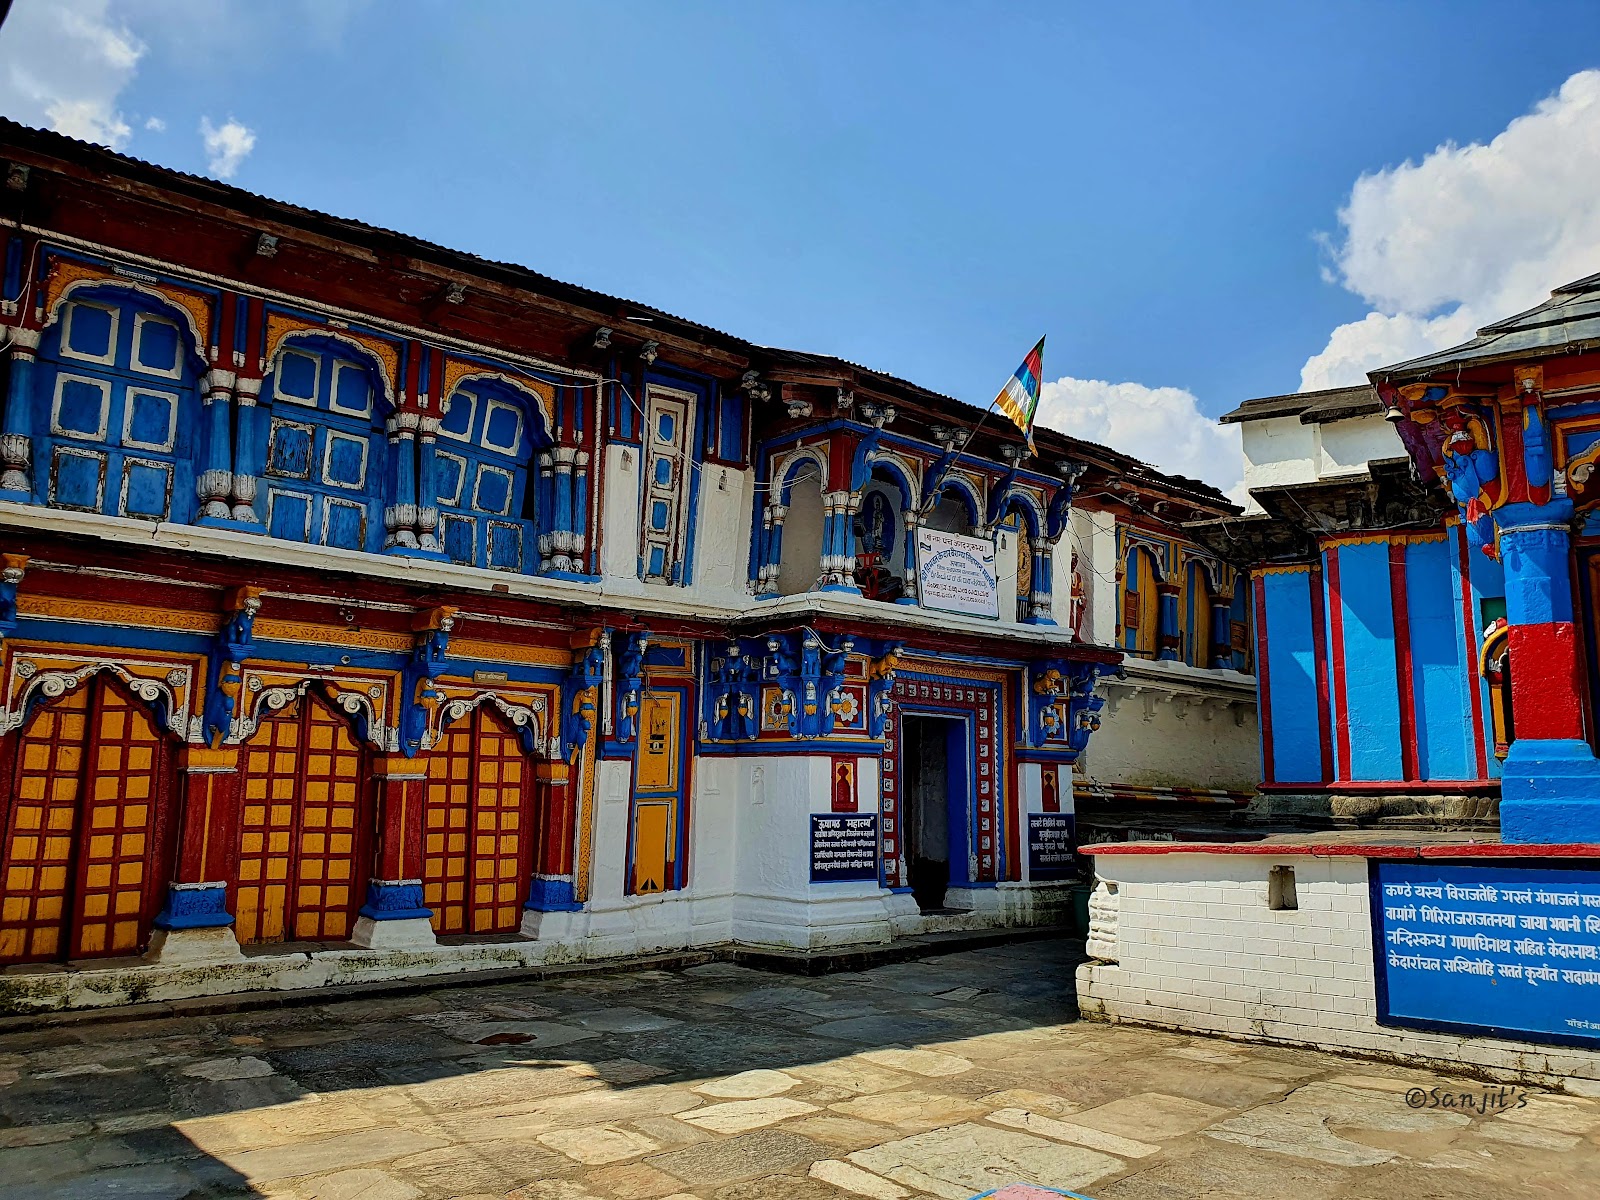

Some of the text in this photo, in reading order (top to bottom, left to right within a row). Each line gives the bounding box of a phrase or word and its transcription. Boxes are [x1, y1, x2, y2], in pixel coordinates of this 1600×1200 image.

[1384, 881, 1412, 898] कण्ठे
[1413, 885, 1443, 900] यस्य
[1444, 883, 1499, 903] विराजतेहि
[1500, 887, 1533, 905] गरलं
[1534, 888, 1580, 907] गंगाजलं
[1385, 904, 1417, 922] वामांगे
[1419, 905, 1516, 929] गिरिराजराजतनया
[1518, 915, 1548, 931] जाया
[1549, 914, 1581, 933] भवानी
[1386, 927, 1599, 960] नन्दिस्कन्ध गणाधिनाथ सहितः केदारनाथः
[1388, 949, 1441, 971] केदारांचल
[1497, 962, 1523, 979] सततं
